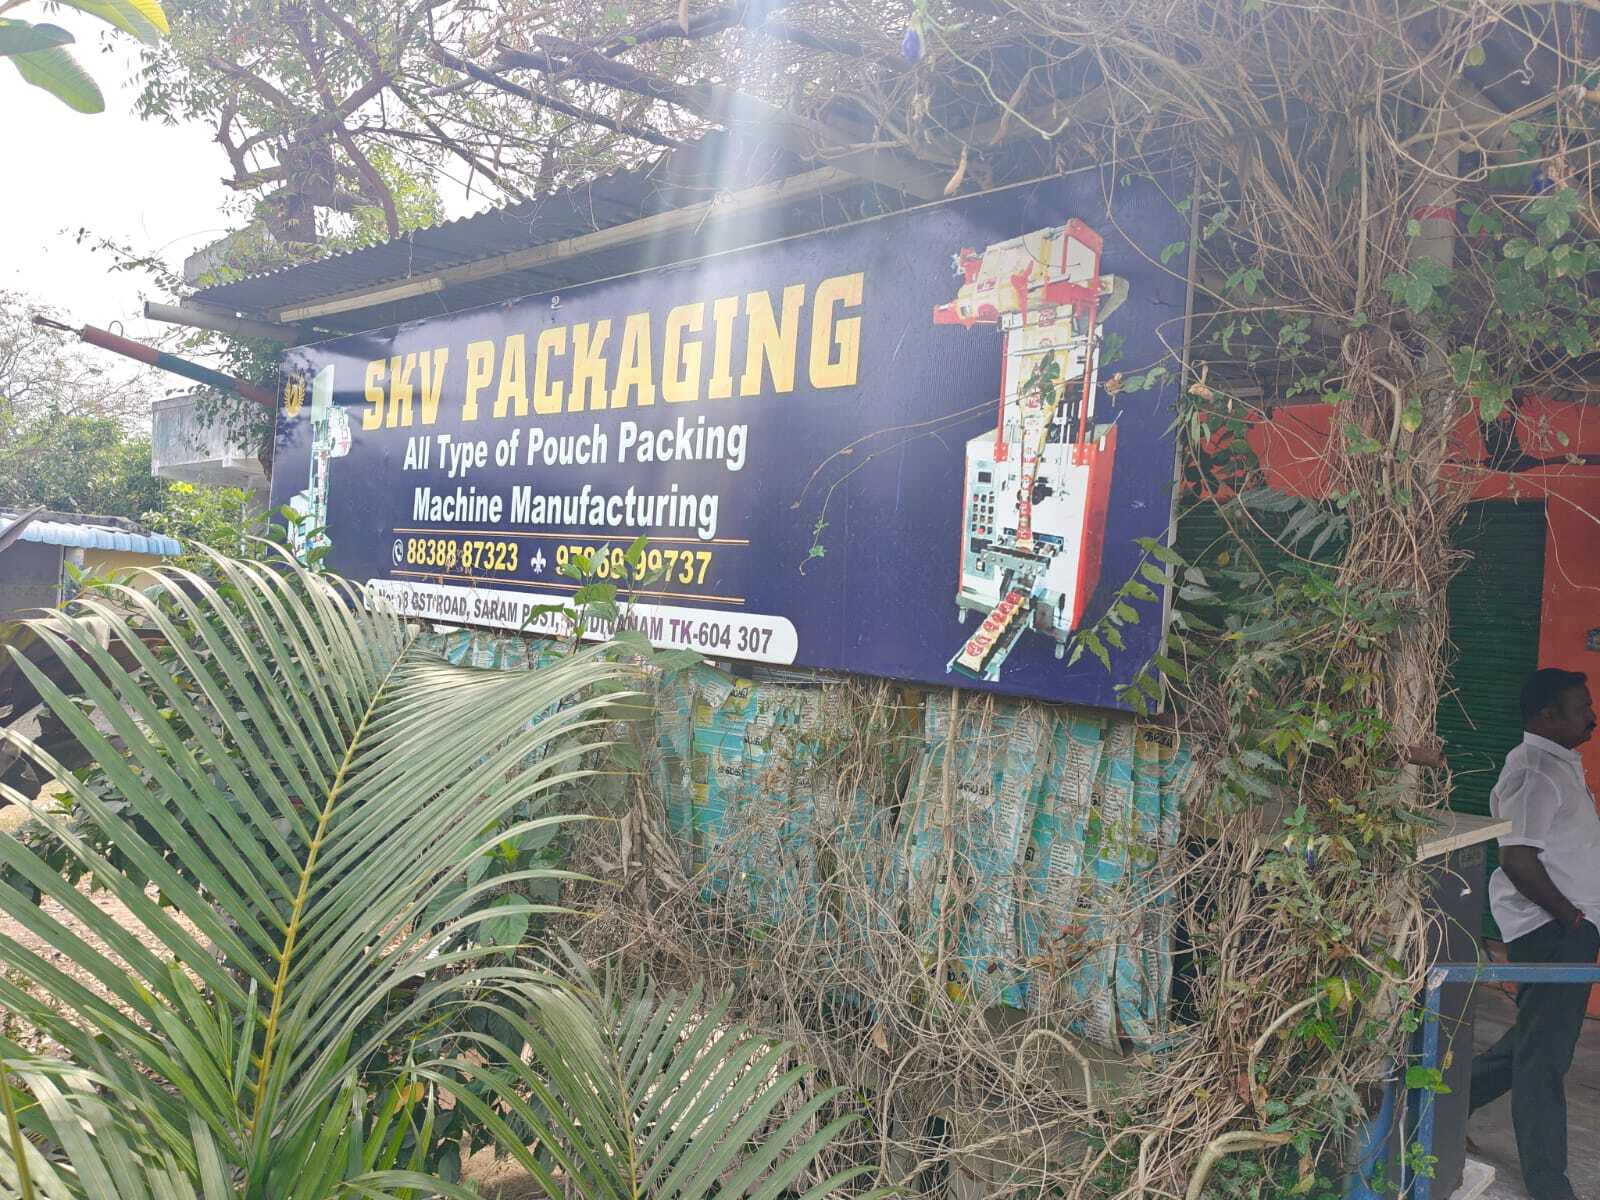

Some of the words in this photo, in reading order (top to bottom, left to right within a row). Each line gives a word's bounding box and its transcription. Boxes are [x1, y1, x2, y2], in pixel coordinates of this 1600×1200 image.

[362, 347, 449, 431] SKV
[462, 271, 865, 422] PACKAGING
[403, 436, 430, 471] All
[436, 434, 488, 478] Type
[495, 429, 520, 466] of
[527, 423, 608, 466] Pouch
[618, 415, 749, 471] Packing
[412, 486, 502, 522] Machine
[510, 483, 720, 540] Manufacturing
[406, 538, 457, 568] 88388
[461, 540, 519, 572] 87323
[436, 594, 470, 621] ROAD,
[473, 599, 518, 623] SARAM
[669, 618, 731, 649] TK-604
[737, 625, 773, 654] 307
